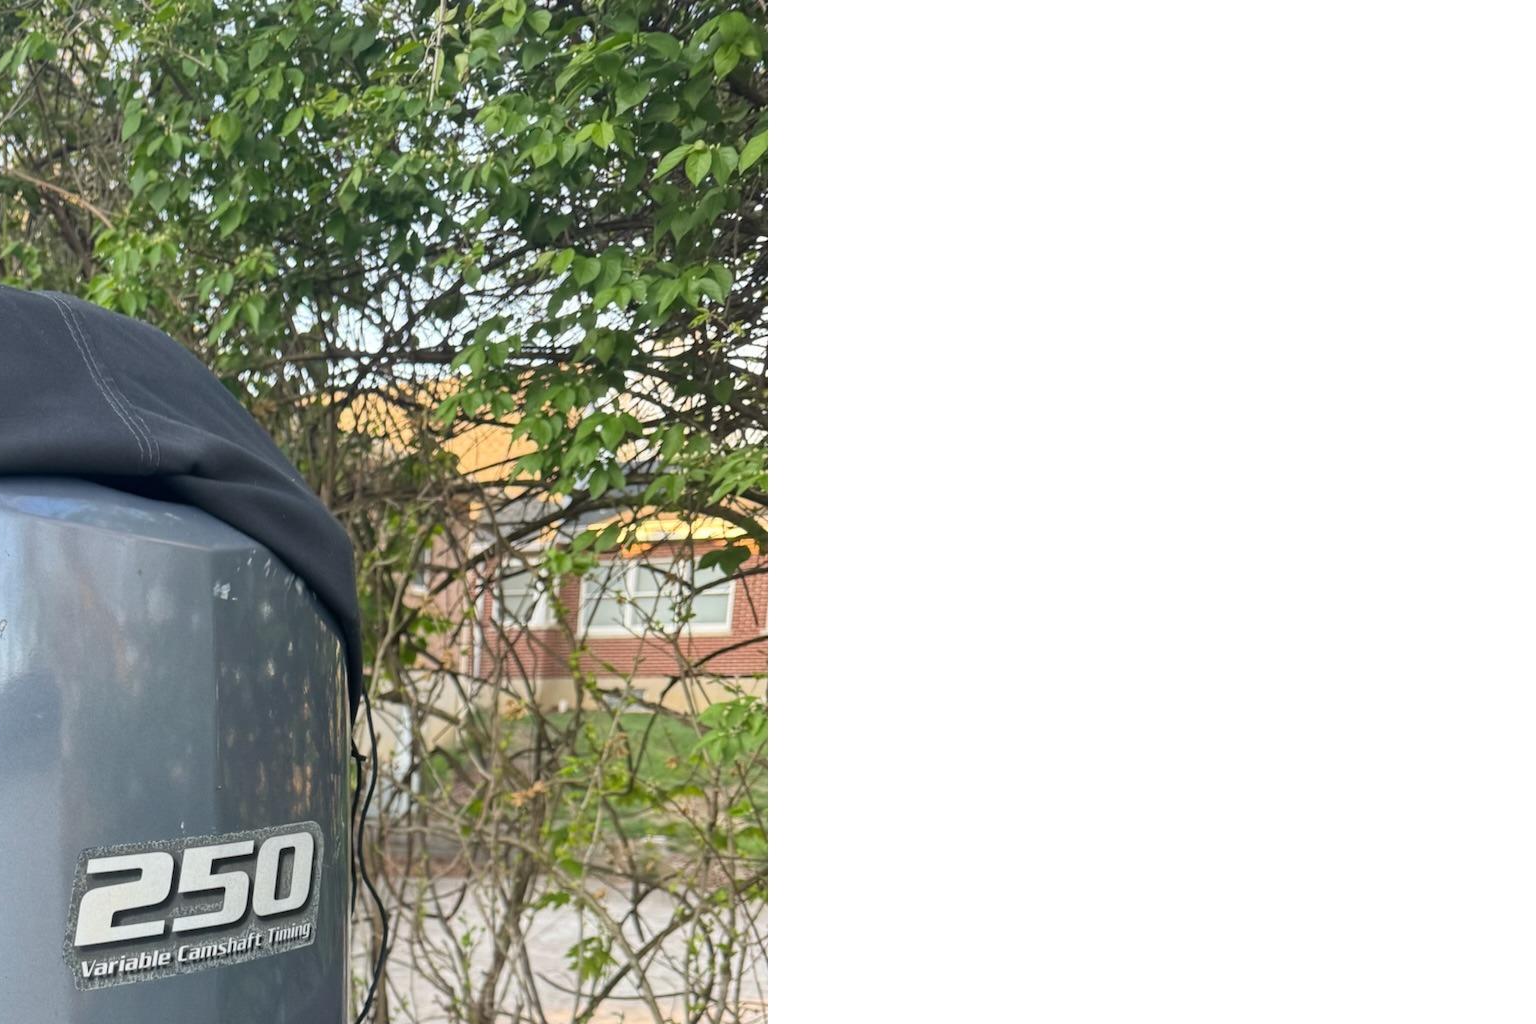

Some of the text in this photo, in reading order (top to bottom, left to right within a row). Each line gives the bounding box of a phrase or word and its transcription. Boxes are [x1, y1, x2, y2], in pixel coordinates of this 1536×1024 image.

[74, 831, 315, 947] 250
[80, 922, 311, 978] Variable Camshaft Timing
